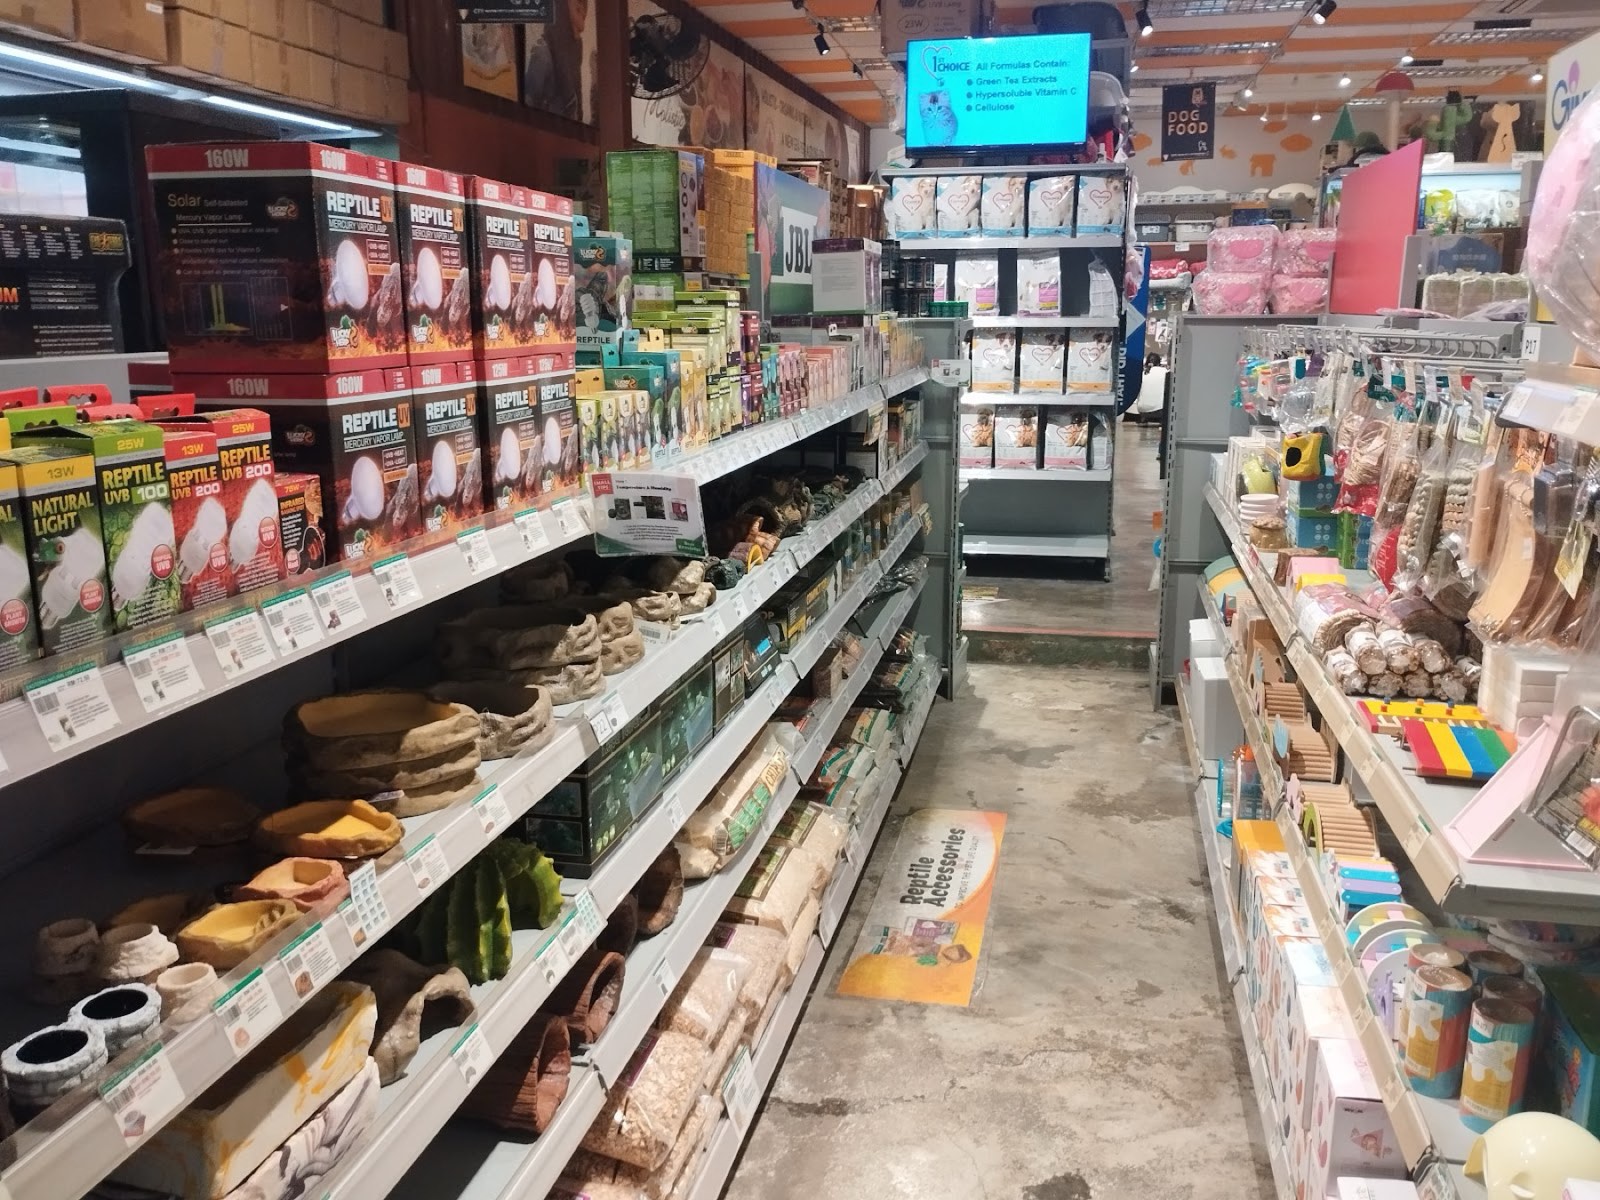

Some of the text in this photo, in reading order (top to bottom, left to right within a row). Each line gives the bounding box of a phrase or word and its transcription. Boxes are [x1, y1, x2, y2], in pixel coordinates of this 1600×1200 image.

[976, 60, 1069, 70] All Formulas Contain:
[976, 78, 1001, 86] Green
[1022, 75, 1057, 84] Extracts
[976, 87, 1077, 100] Hypersoluble Vitamin C
[976, 103, 1015, 112] Cellulose
[1168, 110, 1200, 122] DOG
[1168, 122, 1208, 136] FOOD
[205, 149, 248, 168] 160W
[168, 194, 201, 207] Solar
[326, 191, 381, 218] REPTILE
[410, 204, 453, 227] REPTILE
[329, 219, 387, 233] MERCURY VAPOR LAMP
[486, 216, 520, 236] REPTILE
[534, 224, 564, 242] REPTILE
[786, 224, 812, 274] JBL
[227, 378, 269, 396] 160W
[336, 376, 363, 394] 160W
[541, 383, 568, 400] REPTILE
[426, 398, 466, 420] REPTILE
[495, 390, 528, 410] REPTILE
[232, 423, 254, 433] 25W
[342, 408, 397, 434] REPTILE
[427, 424, 446, 434] MERCURY
[117, 438, 144, 450] 25W
[182, 444, 204, 455] 13W
[344, 432, 403, 449] MERCURY VAPOR LAMP
[220, 444, 270, 467] REPTILE
[47, 466, 74, 479] 13W
[102, 462, 165, 489] REPTILE
[170, 466, 217, 489] REPTILE
[222, 463, 271, 482] UVB 200
[105, 484, 168, 505] UVB 100
[172, 482, 220, 500] UVB 200
[32, 491, 94, 518] NATURAL
[34, 512, 77, 536] LIGHT
[262, 531, 274, 541] UVB
[157, 560, 170, 571] UVB
[213, 556, 226, 567] UVB
[5, 611, 22, 620] PLANT
[923, 828, 966, 907] Accessories
[900, 856, 934, 904] Reptile
